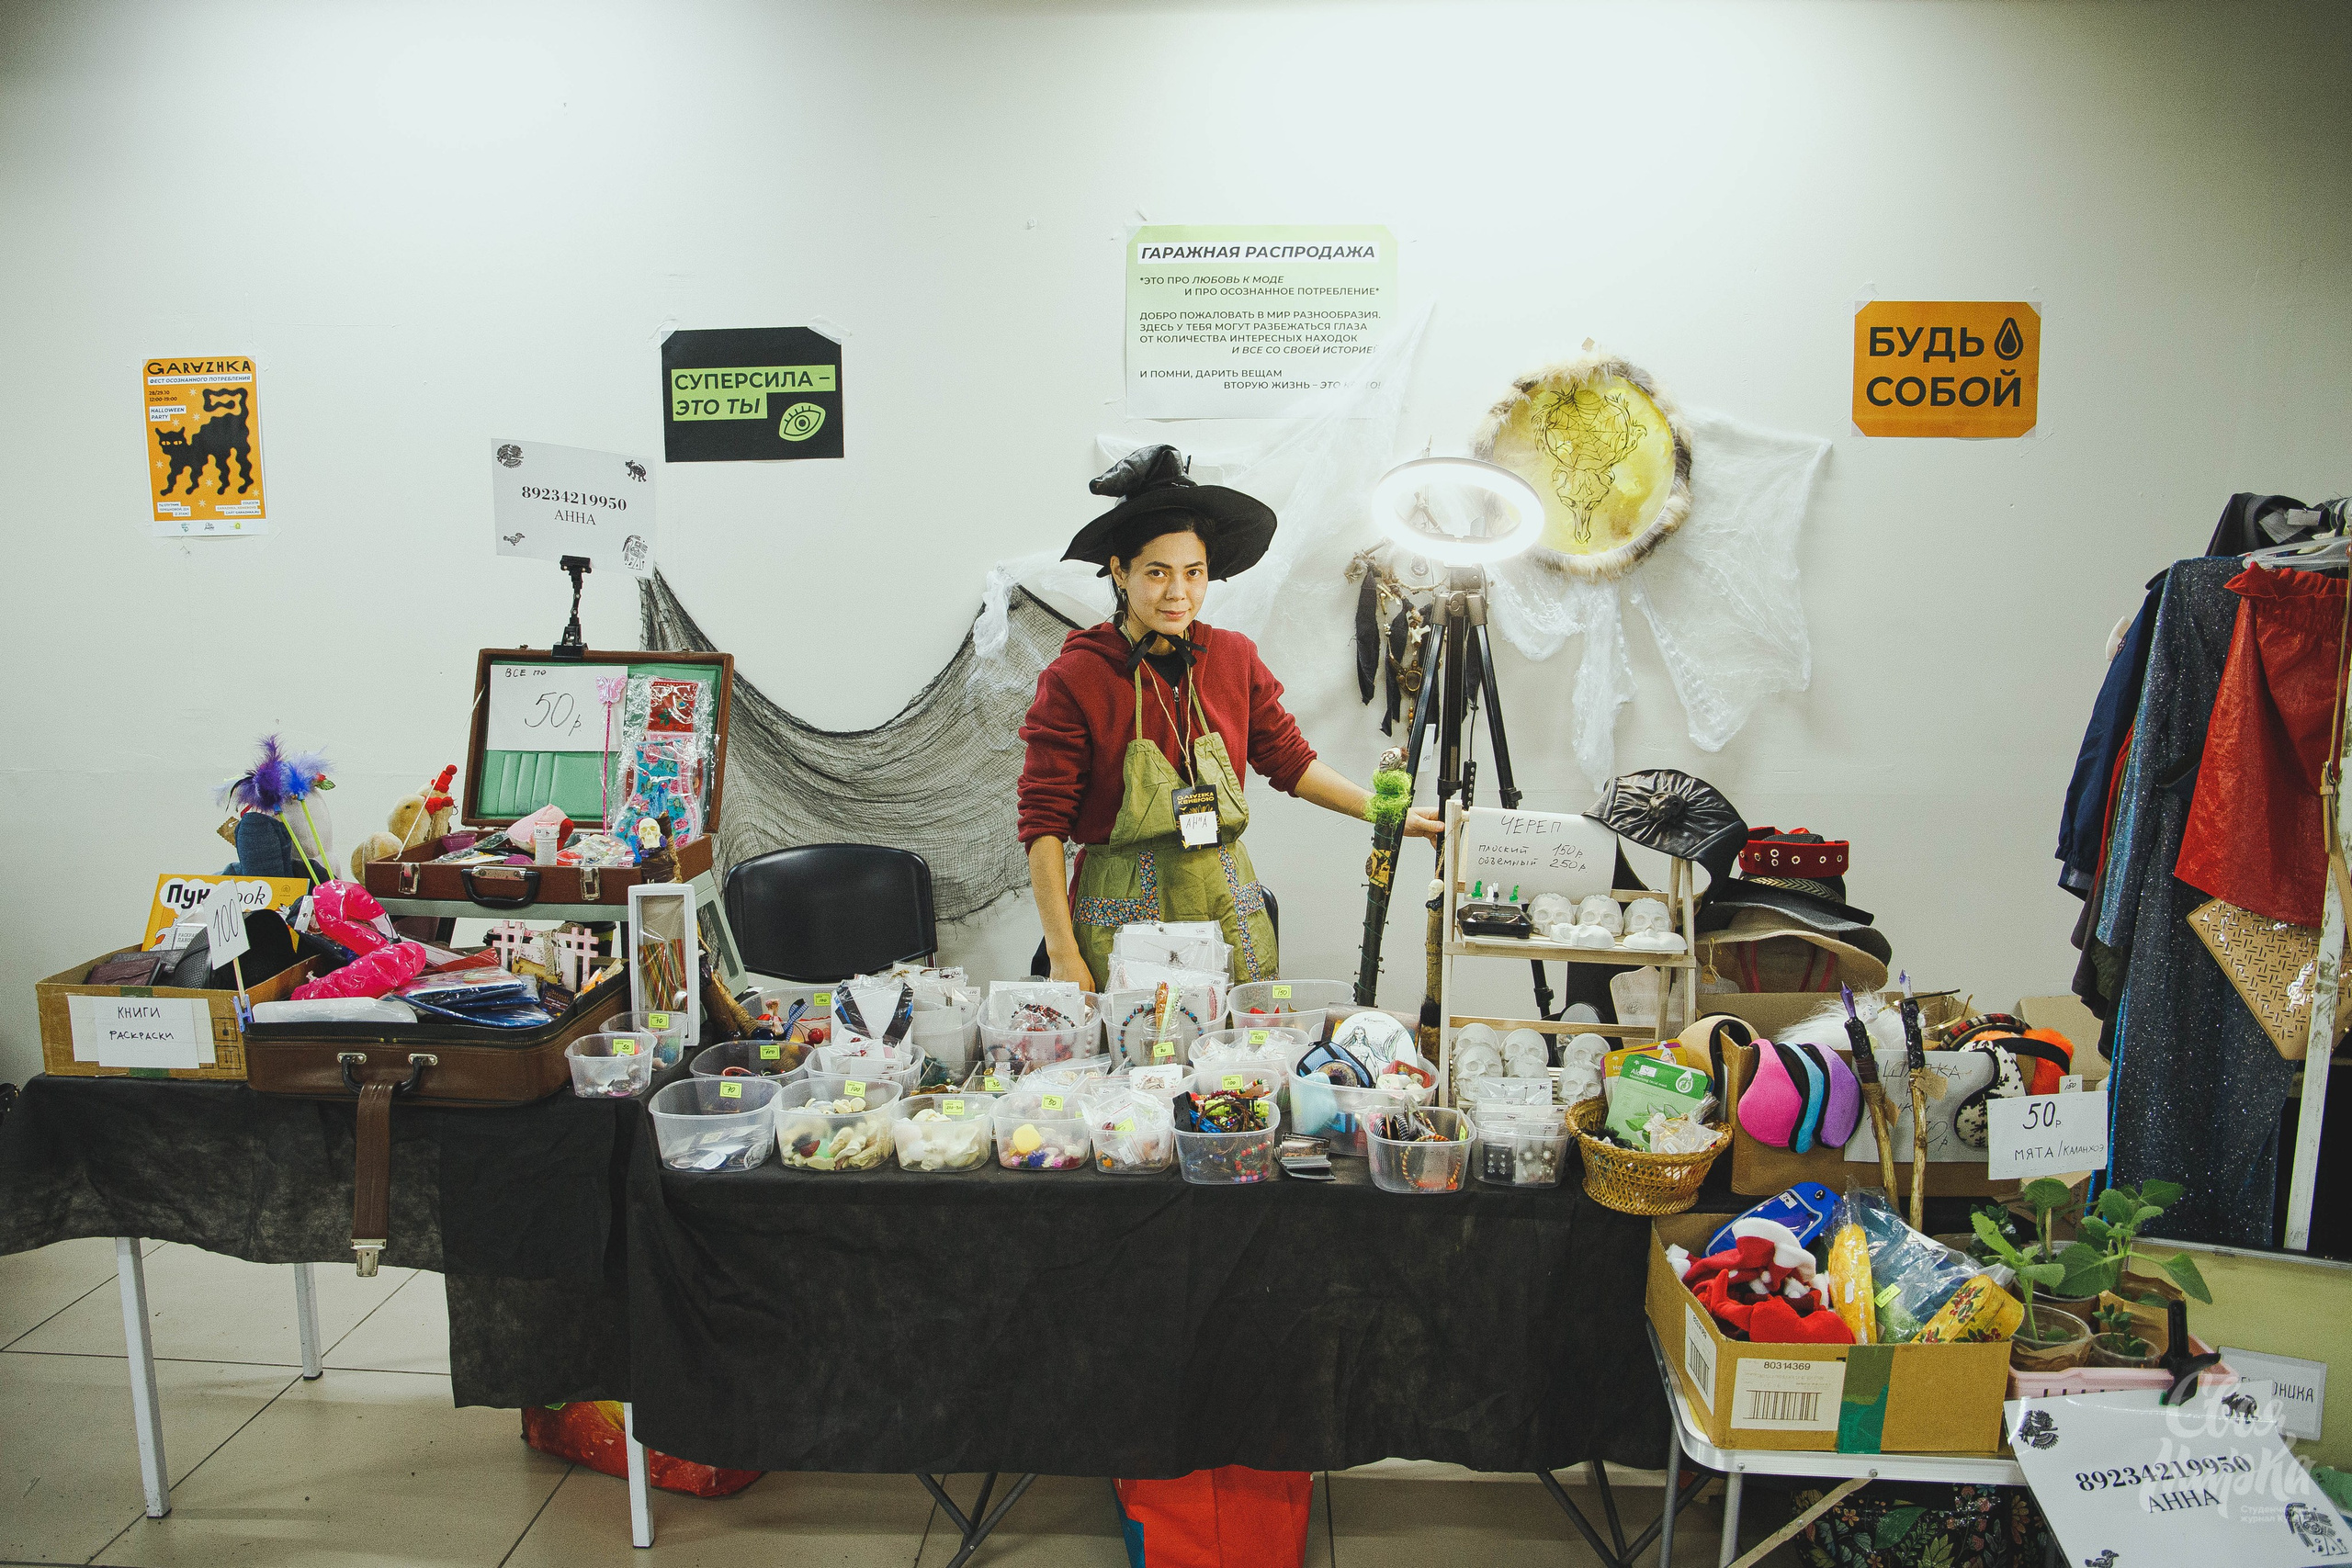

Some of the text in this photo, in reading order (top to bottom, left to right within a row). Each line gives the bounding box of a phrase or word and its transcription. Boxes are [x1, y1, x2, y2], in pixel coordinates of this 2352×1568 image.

[1141, 245, 1375, 260] ГАРАЖНАЯ РАСПРОДАЖА
[1167, 276, 1190, 285] ПРО
[1192, 276, 1240, 285] ЛЮБОВЬ
[1242, 276, 1250, 285] К
[1252, 275, 1284, 285] МОДЕ
[1184, 288, 1192, 296] И
[1194, 288, 1217, 296] ПРО
[1219, 288, 1295, 296] ОСОЗНАННОЕ
[1139, 310, 1381, 321] ДОБРО ПОЖАЛОВАТЬ В МИР РАЗНООБРАЗИЯ.
[1140, 321, 1368, 333] ЗДЕСЬ У ТЕБЯ МОГУТ РАЗБЕЖАТЬСЯ ГЛАЗА
[1139, 333, 1358, 344] ОТ КОЛИЧЕСТВА ИНТЕРЕСНЫХ НАХОДОК
[1870, 327, 1984, 363] БУДЬ
[1231, 345, 1239, 355] И
[1242, 345, 1263, 355] ВСЕ
[1265, 345, 1281, 355] СО
[1283, 344, 1319, 355] СВОЕЙ
[674, 371, 813, 390] СУПЕРСИЛА
[1140, 369, 1283, 379] И ПОМНИ, ДАРИТЬ ВЕЩАМ
[1224, 381, 1268, 389] ВТОРУЮ
[1271, 380, 1310, 389] ЖИЗНЬ
[1319, 380, 1340, 389] ЭТО
[1866, 369, 2020, 407] СОБОЙ
[675, 398, 761, 416] ЭТО ТЫ
[522, 486, 627, 511] 89234219950
[554, 509, 596, 525] АННА
[505, 668, 526, 677] ВСЕ
[1501, 815, 1562, 835] ЧЕРЕП
[213, 898, 239, 947] 100
[117, 1006, 161, 1020] КНИГИ
[109, 1031, 175, 1041] РАСКРАСКИ
[1763, 1361, 1811, 1371] 80314369
[2075, 1455, 2252, 1491] 89234219950
[2148, 1488, 2222, 1514] АННА
